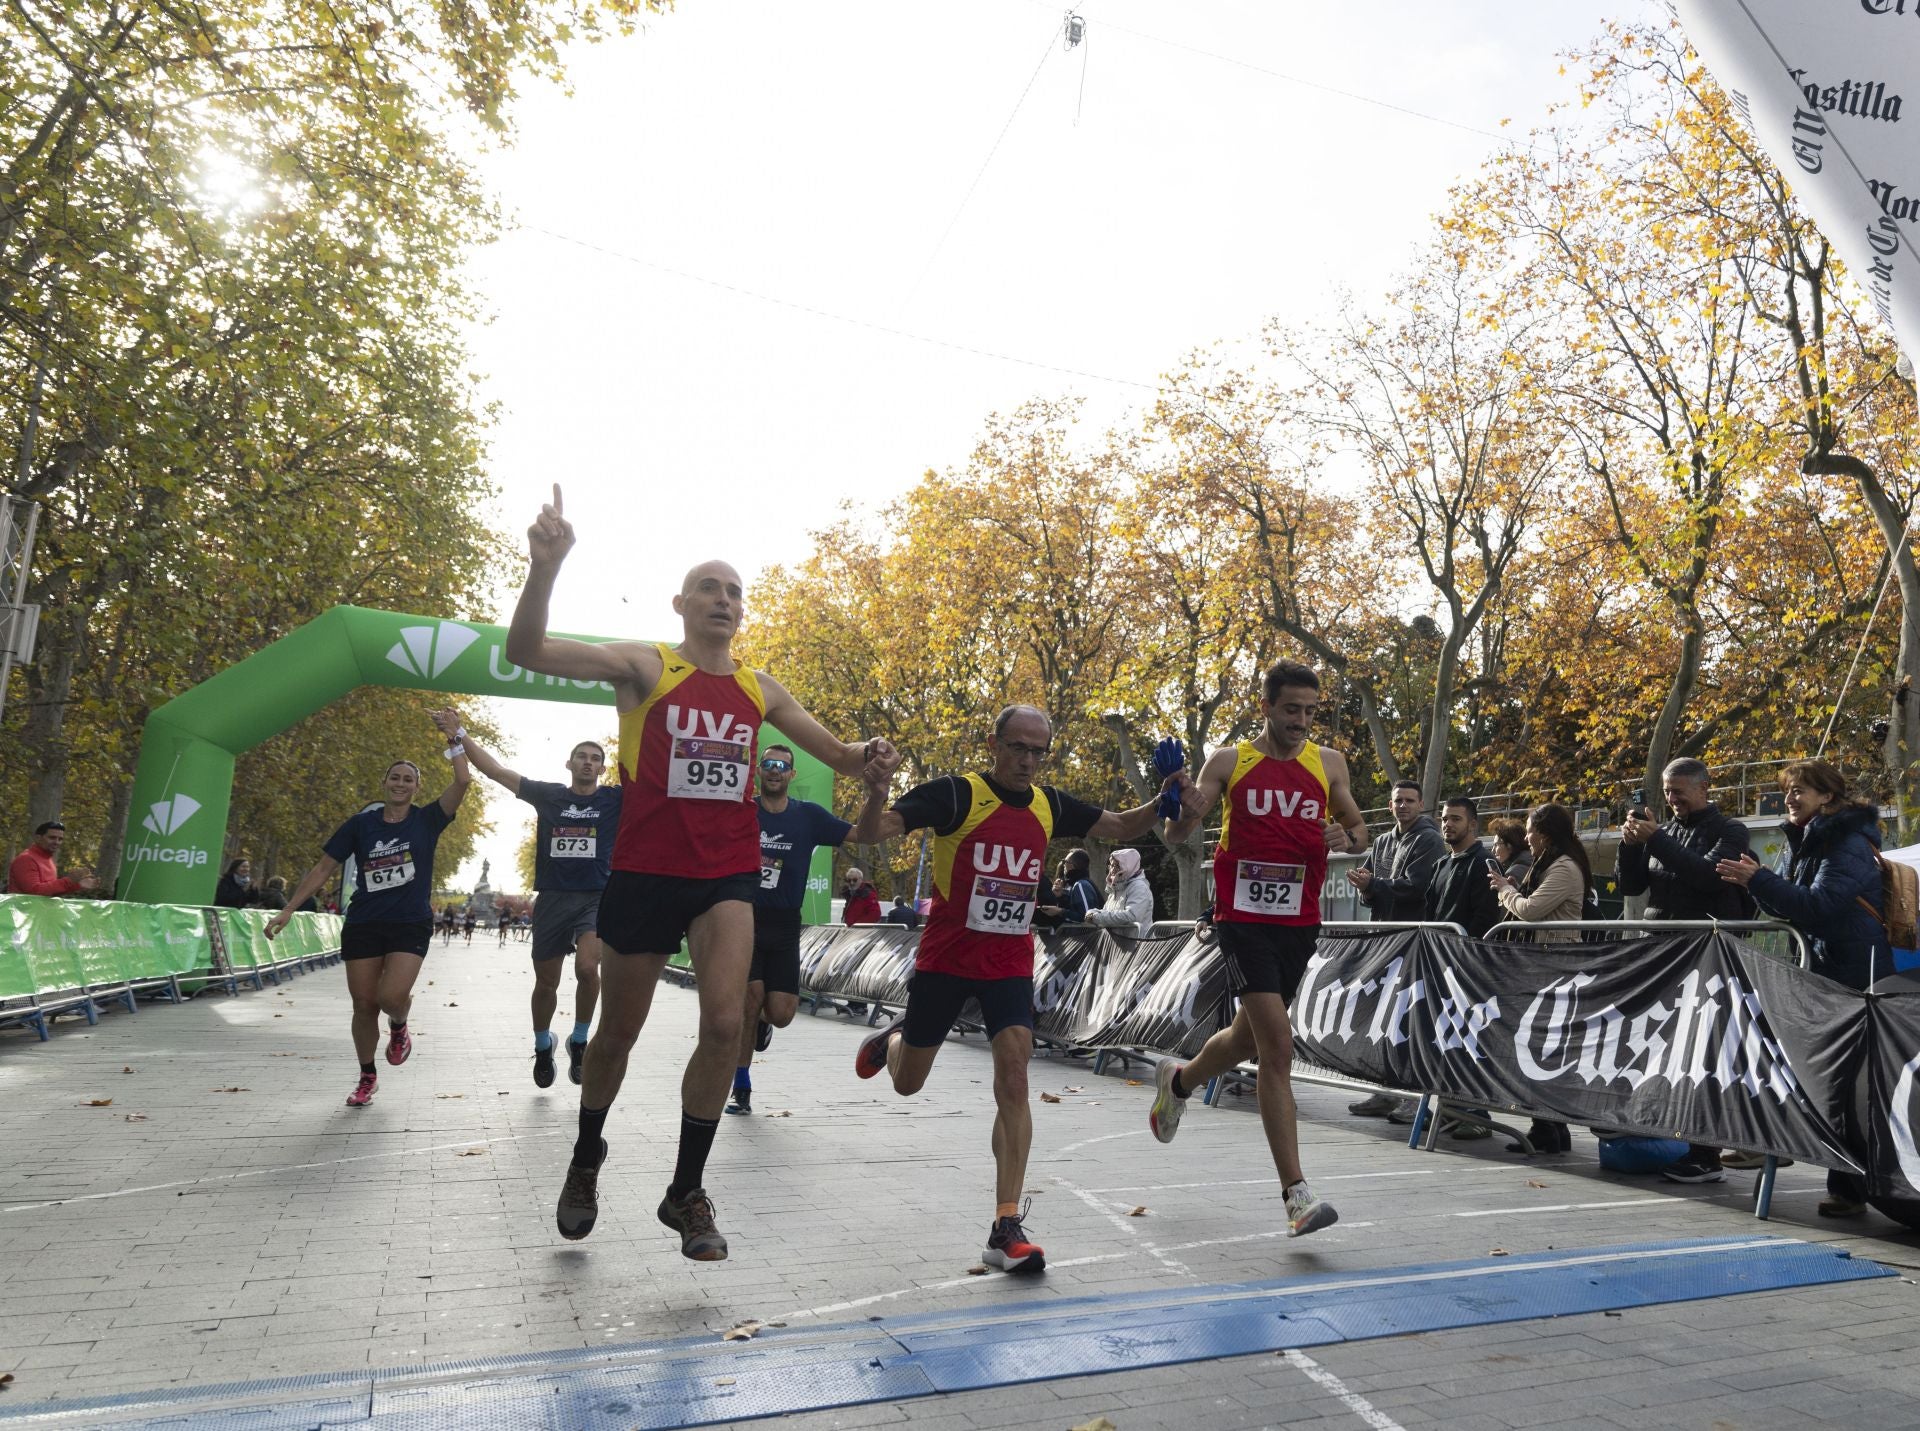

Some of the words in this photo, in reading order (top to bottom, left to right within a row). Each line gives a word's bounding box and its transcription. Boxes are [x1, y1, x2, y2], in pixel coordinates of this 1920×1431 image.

[666, 704, 753, 746] UVa
[687, 760, 739, 788] 953
[560, 811, 600, 819] MICHELIN
[1246, 788, 1320, 820] UVa
[126, 843, 208, 869] Unicaja
[368, 843, 410, 859] MICHELIN
[557, 838, 589, 851] 673
[973, 842, 1041, 881] UVa
[372, 866, 406, 884] 671
[1248, 881, 1291, 904] 952
[982, 898, 1027, 924] 954
